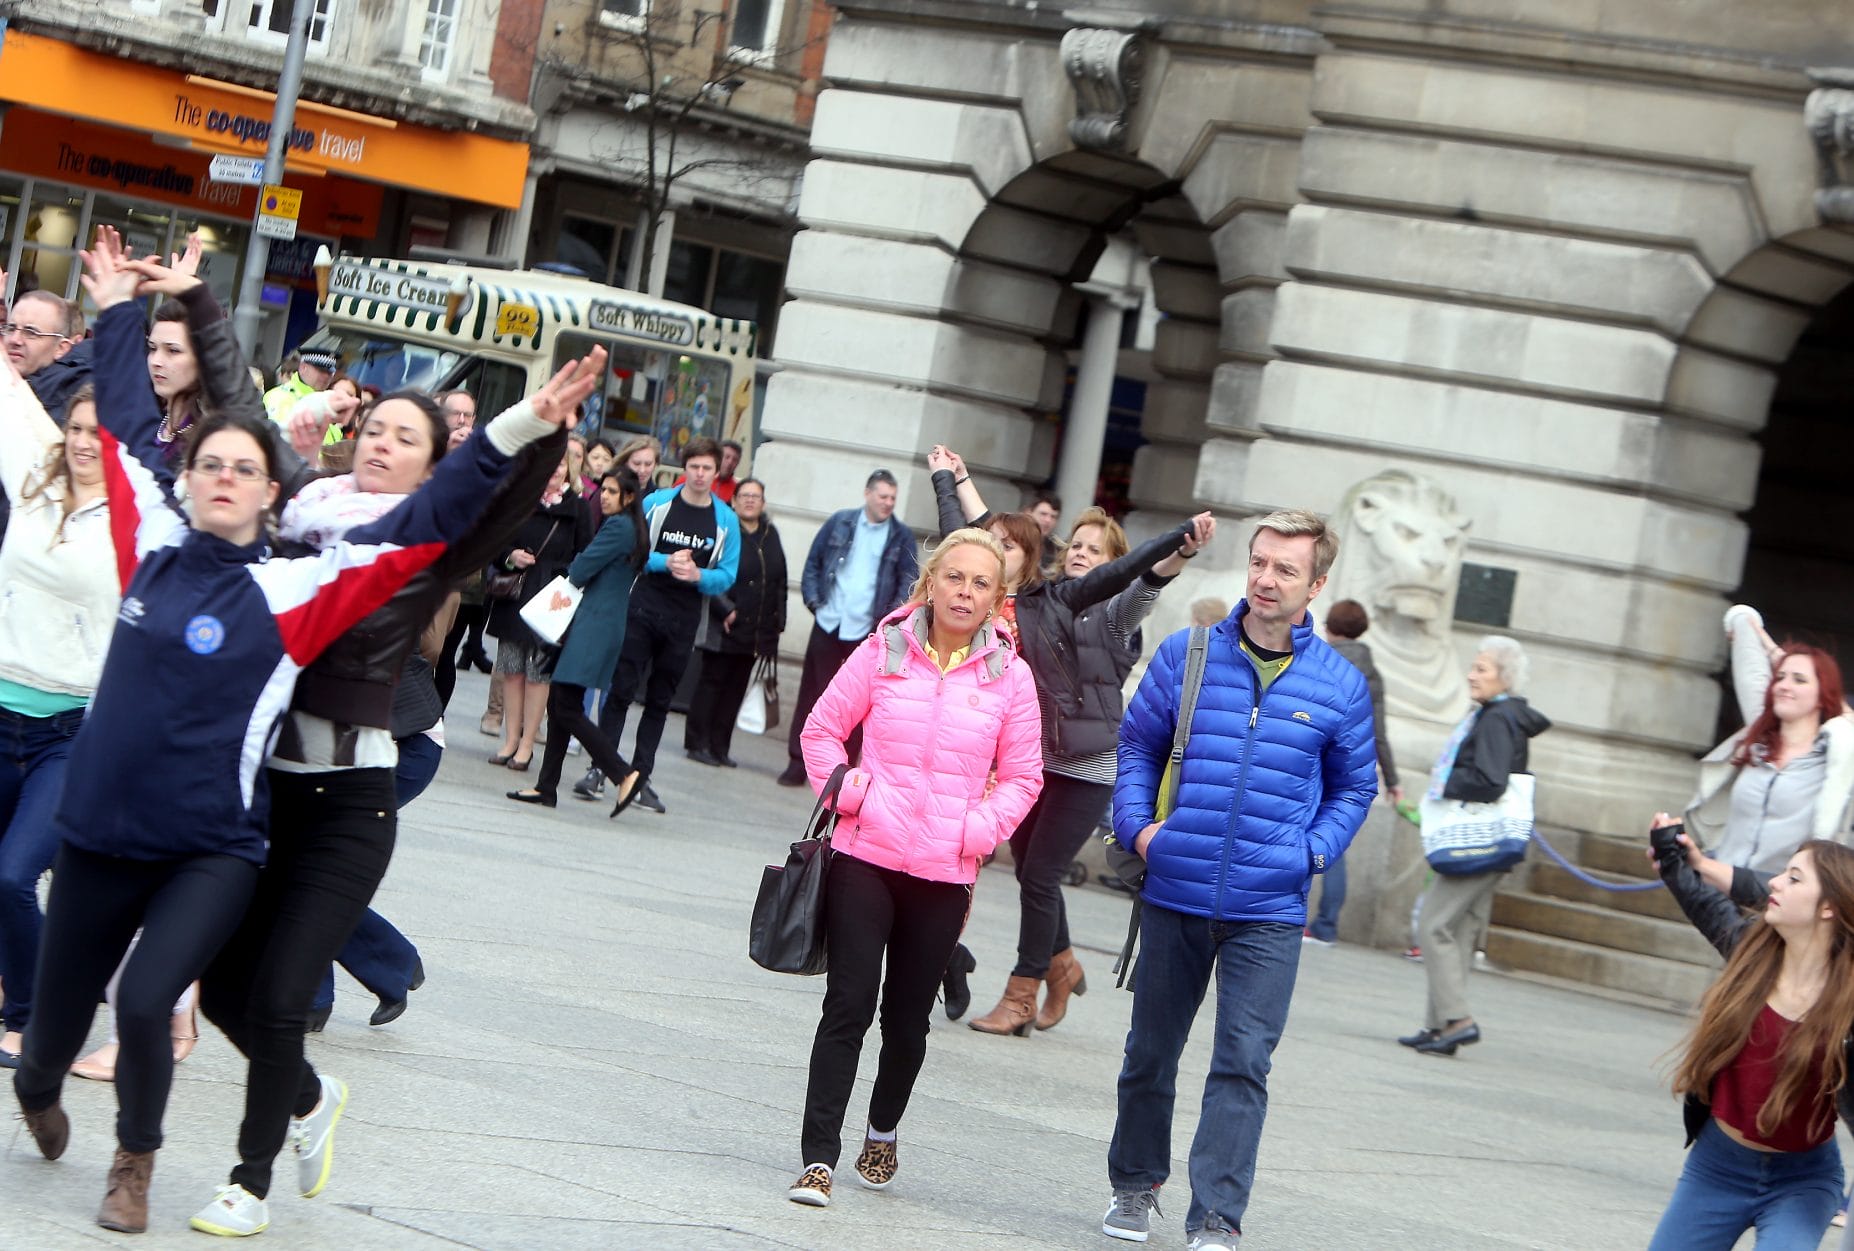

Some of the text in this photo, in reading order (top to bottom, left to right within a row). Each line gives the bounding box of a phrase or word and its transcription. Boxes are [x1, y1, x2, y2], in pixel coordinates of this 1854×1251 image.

[174, 94, 365, 162] The co-operive travel
[57, 143, 242, 207] The co-operative travel
[334, 265, 363, 290] Soft
[366, 271, 391, 296] Ice
[507, 310, 530, 324] 99
[596, 304, 686, 342] Soft Whippy
[662, 530, 705, 549] notts tv
